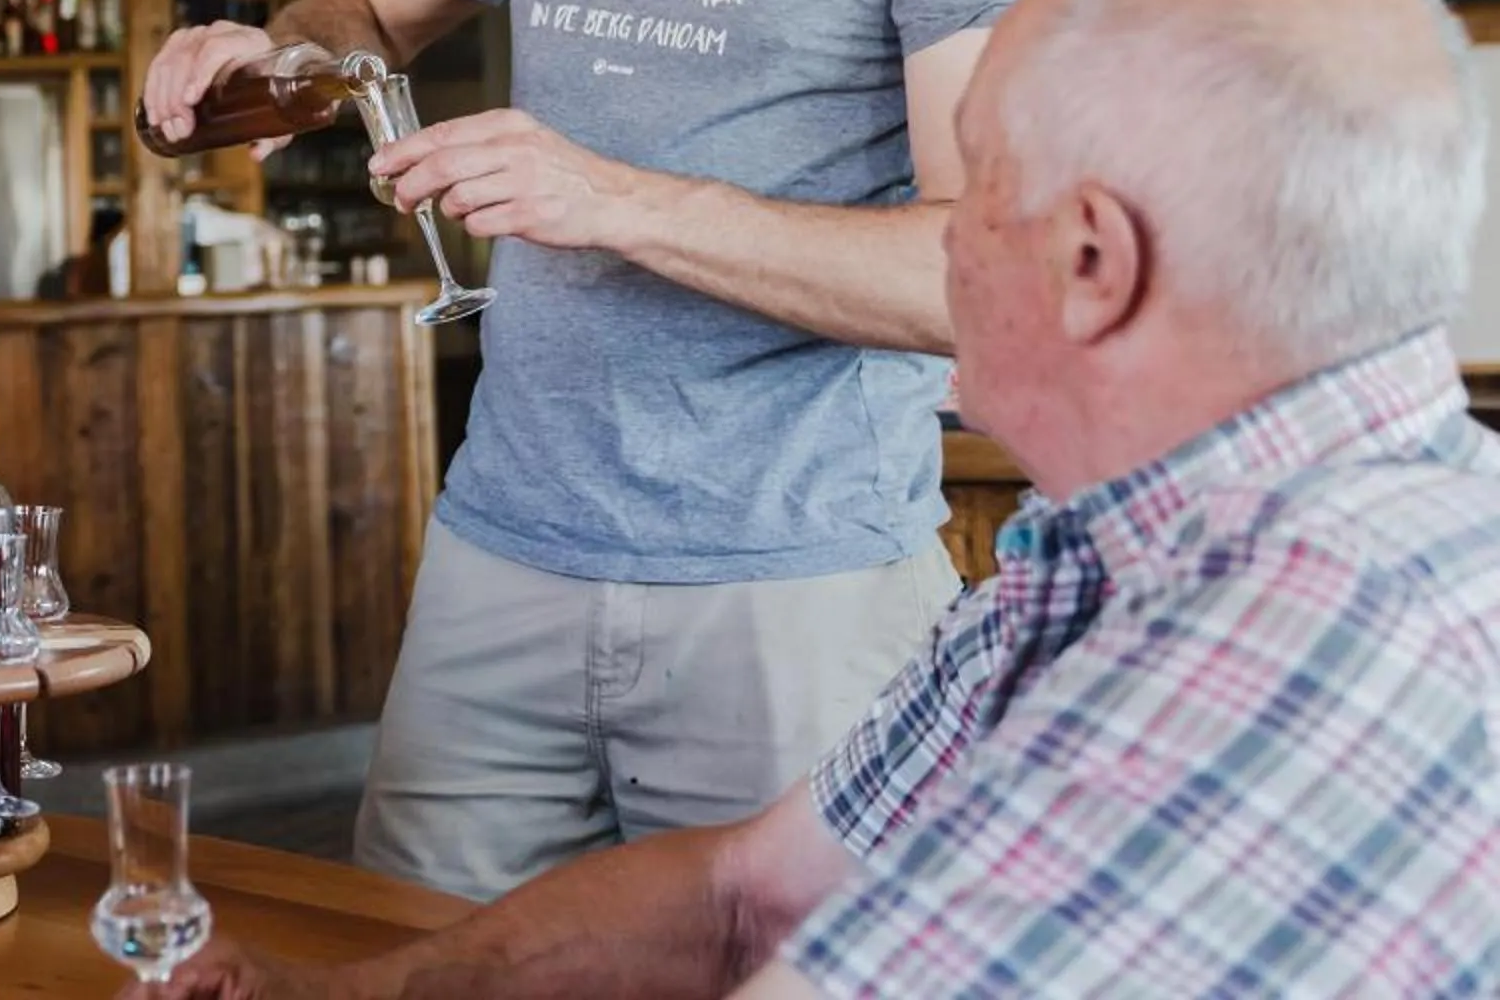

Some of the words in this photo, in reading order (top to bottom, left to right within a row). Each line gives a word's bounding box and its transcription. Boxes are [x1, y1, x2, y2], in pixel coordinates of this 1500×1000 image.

[554, 4, 581, 32] DE
[583, 8, 635, 40] BERG
[638, 16, 728, 56] DAHOAM
